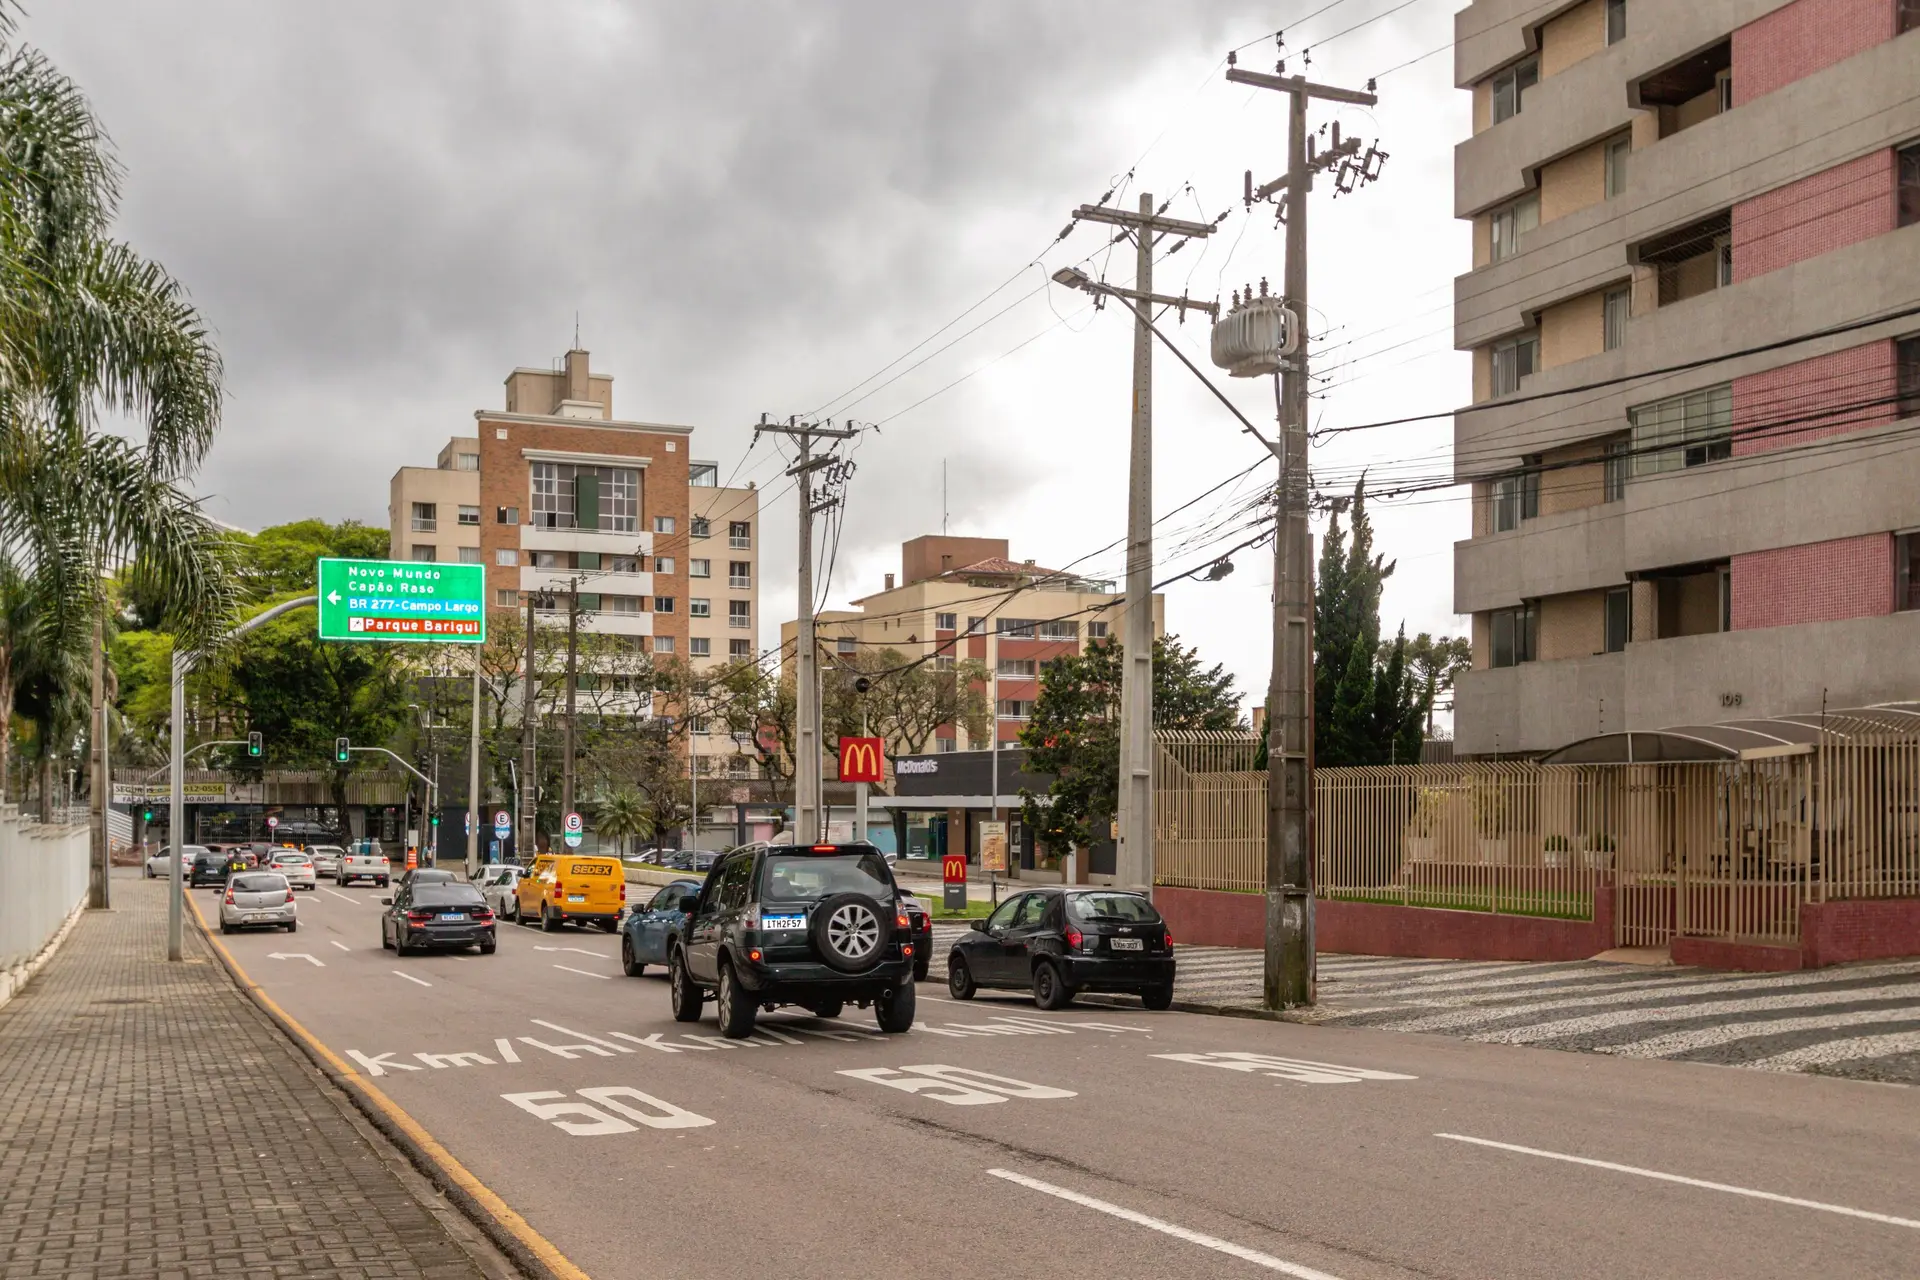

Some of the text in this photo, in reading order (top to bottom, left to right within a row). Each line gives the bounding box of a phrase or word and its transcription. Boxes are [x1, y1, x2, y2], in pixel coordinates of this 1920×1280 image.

[349, 566, 441, 580] Novo Mundo
[349, 581, 435, 593] Capão Raso
[349, 599, 367, 609] BR
[445, 601, 479, 613] Largo
[365, 618, 479, 633] Parque Barigui
[896, 759, 938, 774] McDonald's
[184, 785, 224, 793] 612-0556
[499, 814, 506, 823] E
[570, 817, 577, 827] E
[572, 864, 611, 875] SEDEX
[1147, 1050, 1420, 1085] 50
[833, 1063, 1080, 1106] 50
[499, 1086, 718, 1137] 50
